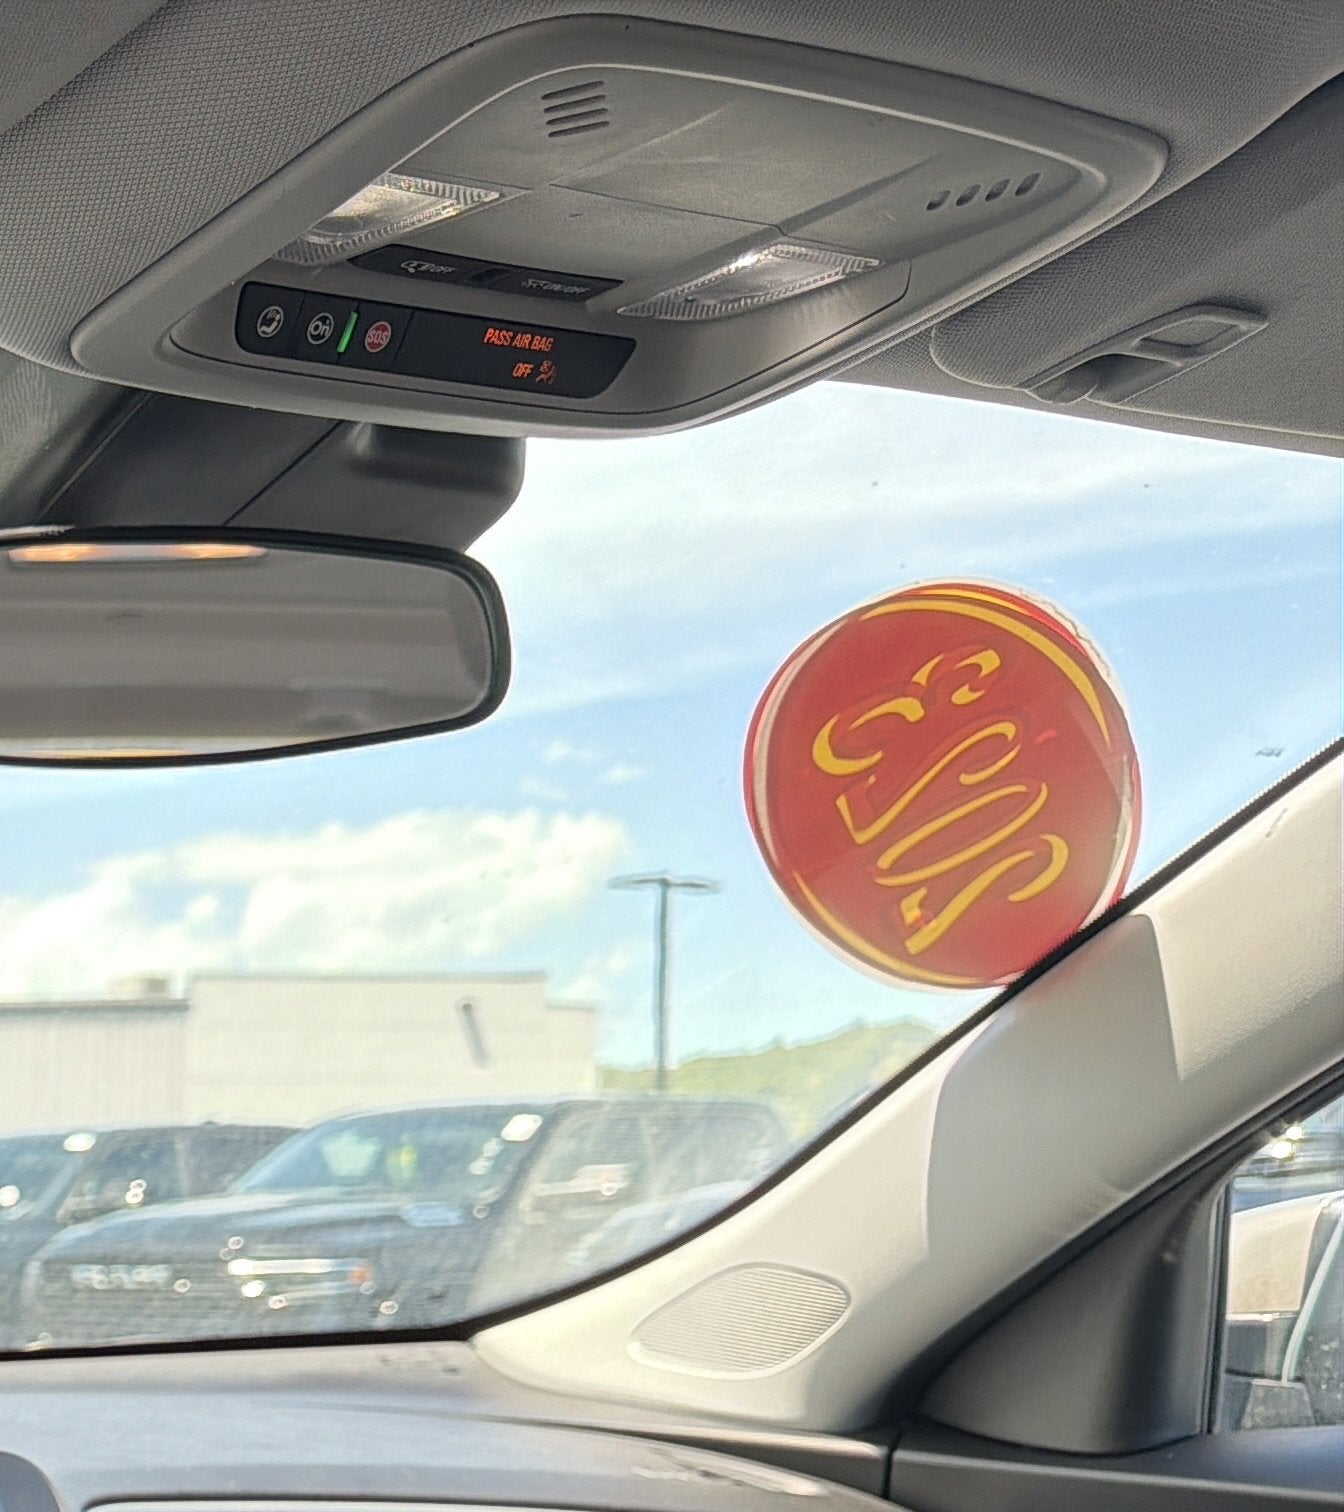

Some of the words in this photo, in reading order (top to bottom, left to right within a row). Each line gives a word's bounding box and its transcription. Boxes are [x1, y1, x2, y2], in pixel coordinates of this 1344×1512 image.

[367, 329, 389, 344] SOS
[483, 327, 512, 346] PASS
[512, 333, 530, 349] AIR
[530, 335, 555, 352] BAG
[512, 362, 534, 378] OFF
